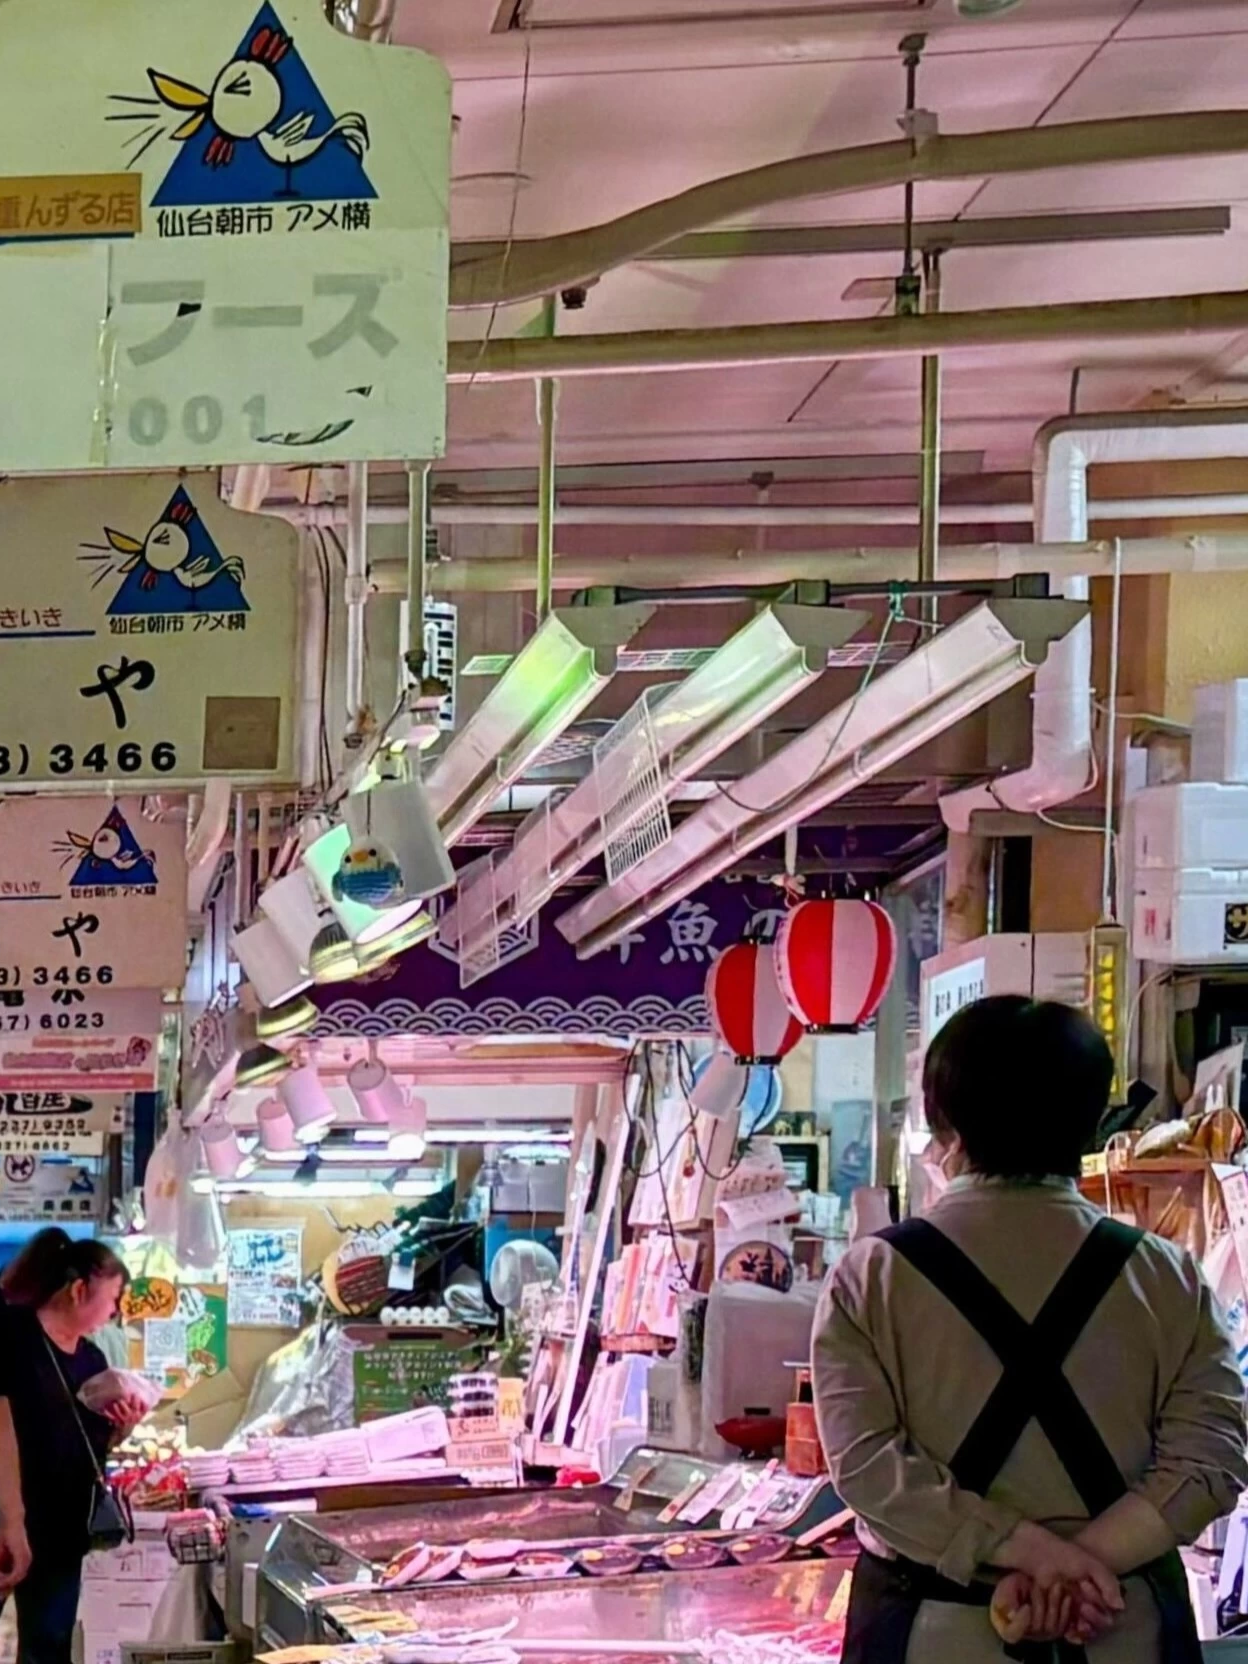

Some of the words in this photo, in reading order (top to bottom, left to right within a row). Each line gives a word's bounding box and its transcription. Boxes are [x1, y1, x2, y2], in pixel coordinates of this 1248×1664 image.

[157, 208, 272, 239] 仙台朝市
[287, 201, 371, 232] アメ横
[109, 616, 184, 635] 仙台朝市
[191, 613, 246, 632] アメ横
